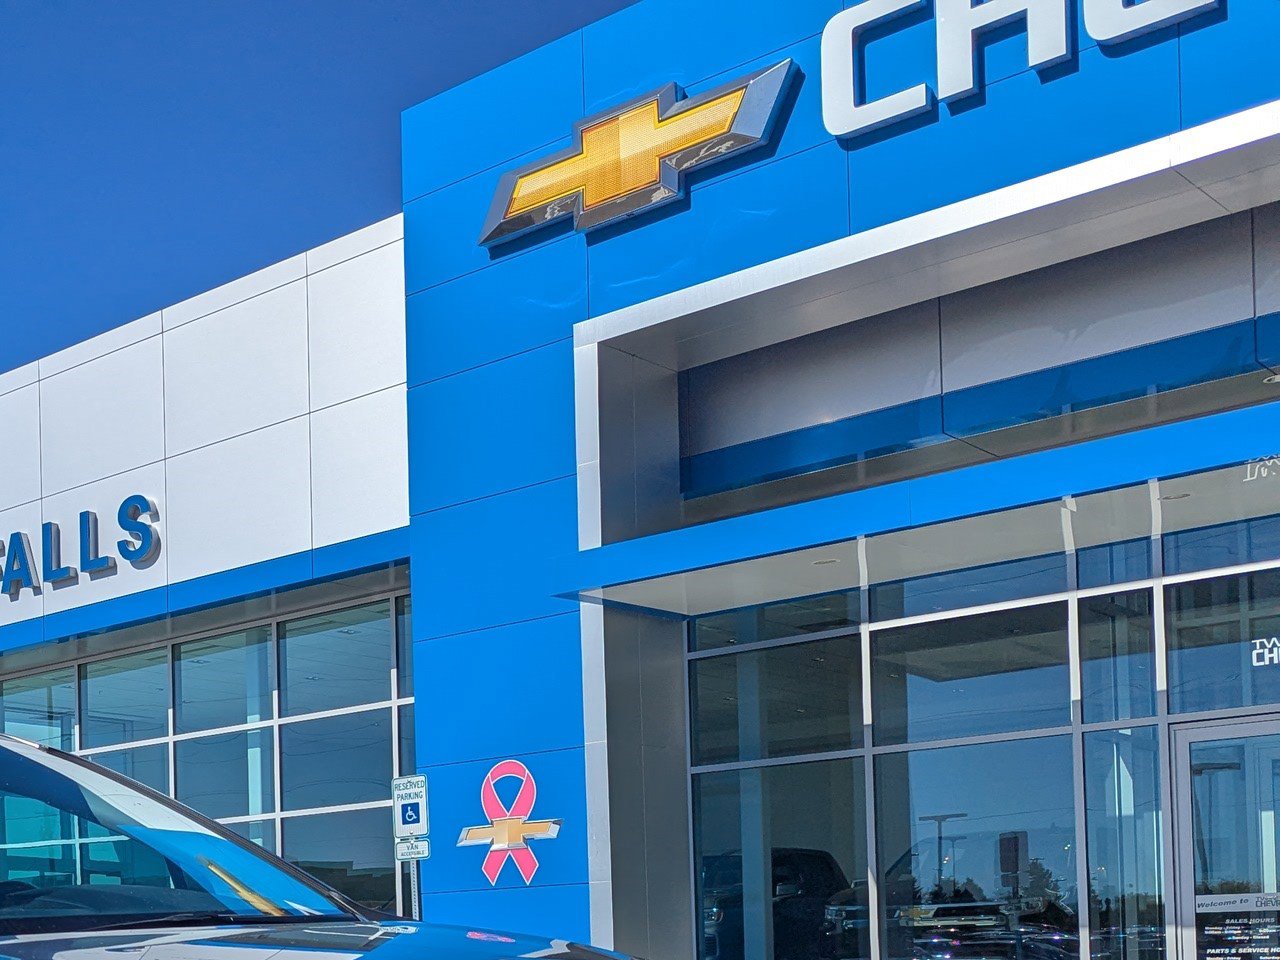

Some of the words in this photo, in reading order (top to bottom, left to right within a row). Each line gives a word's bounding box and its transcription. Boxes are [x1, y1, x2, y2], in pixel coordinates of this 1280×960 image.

[394, 780, 425, 792] RESERVED
[396, 791, 423, 802] PARKING
[406, 843, 419, 851] VAN
[1197, 899, 1237, 909] Welcome
